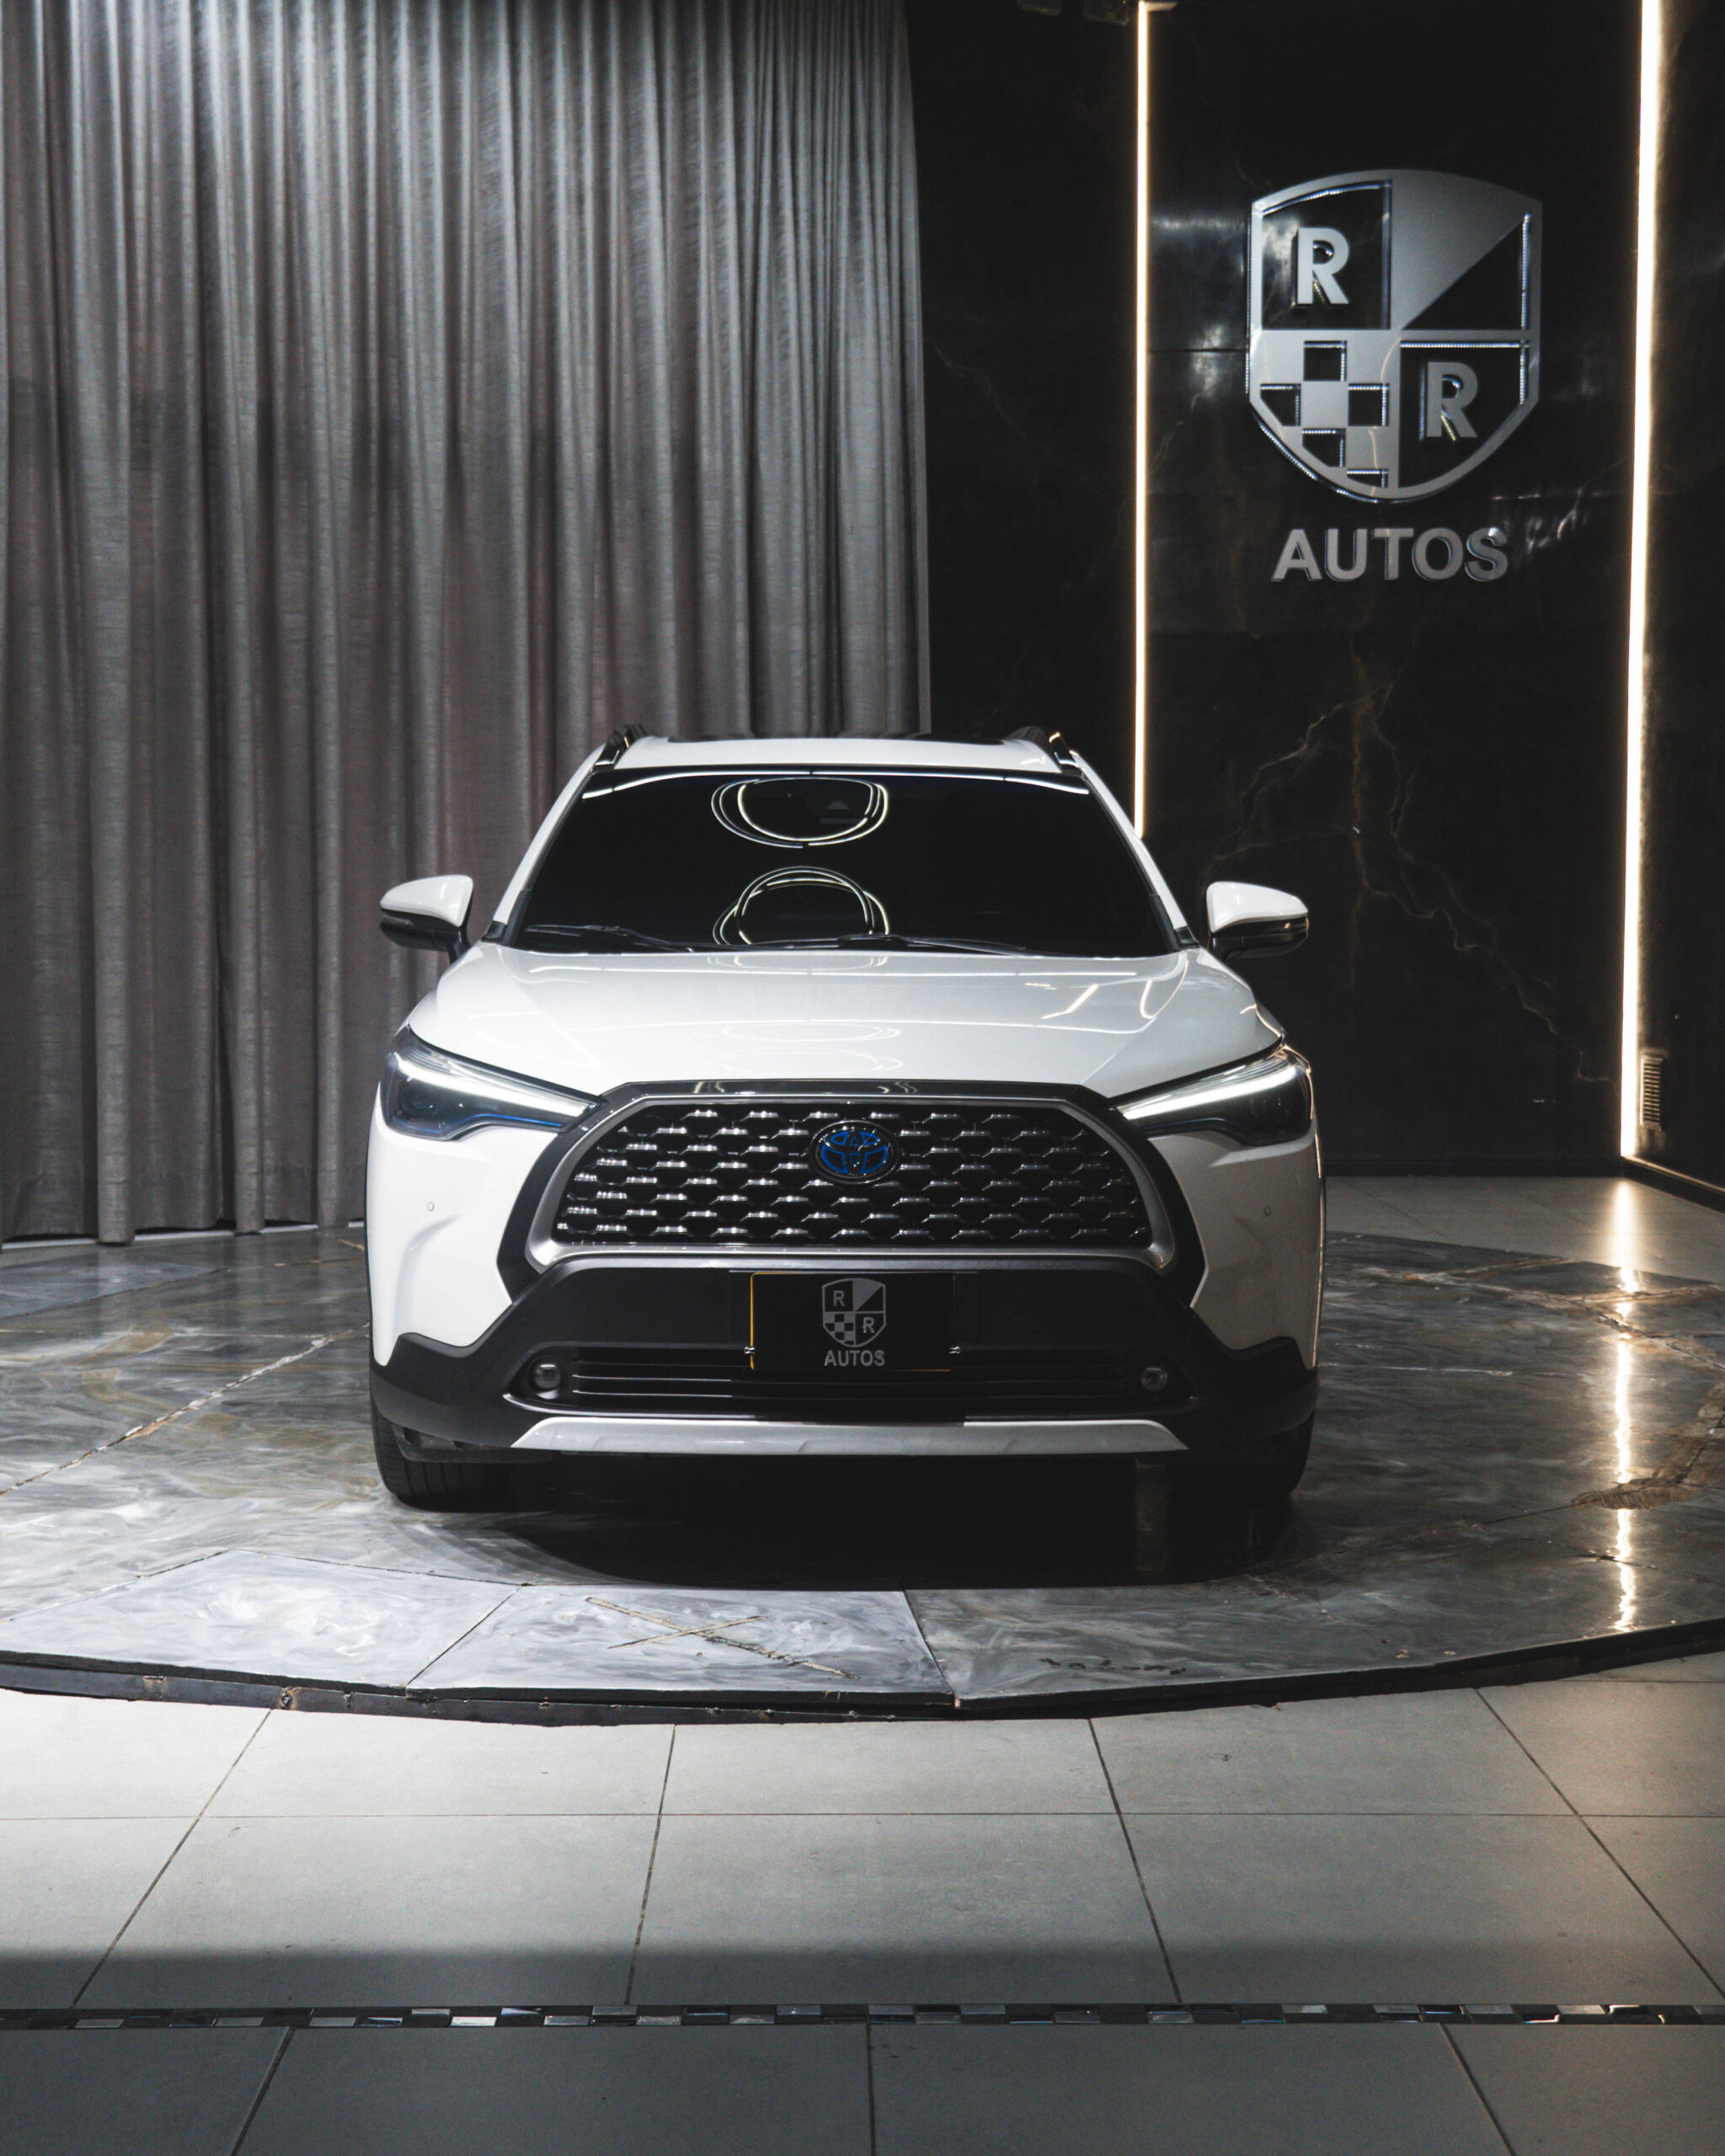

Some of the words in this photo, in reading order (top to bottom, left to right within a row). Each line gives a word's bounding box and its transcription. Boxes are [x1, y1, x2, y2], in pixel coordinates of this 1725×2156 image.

[1295, 227, 1349, 305] R
[1423, 361, 1478, 439] R
[1271, 527, 1509, 582] AUTOS
[833, 1290, 846, 1307] R
[862, 1316, 875, 1334] R
[824, 1349, 885, 1367] AUTOS
